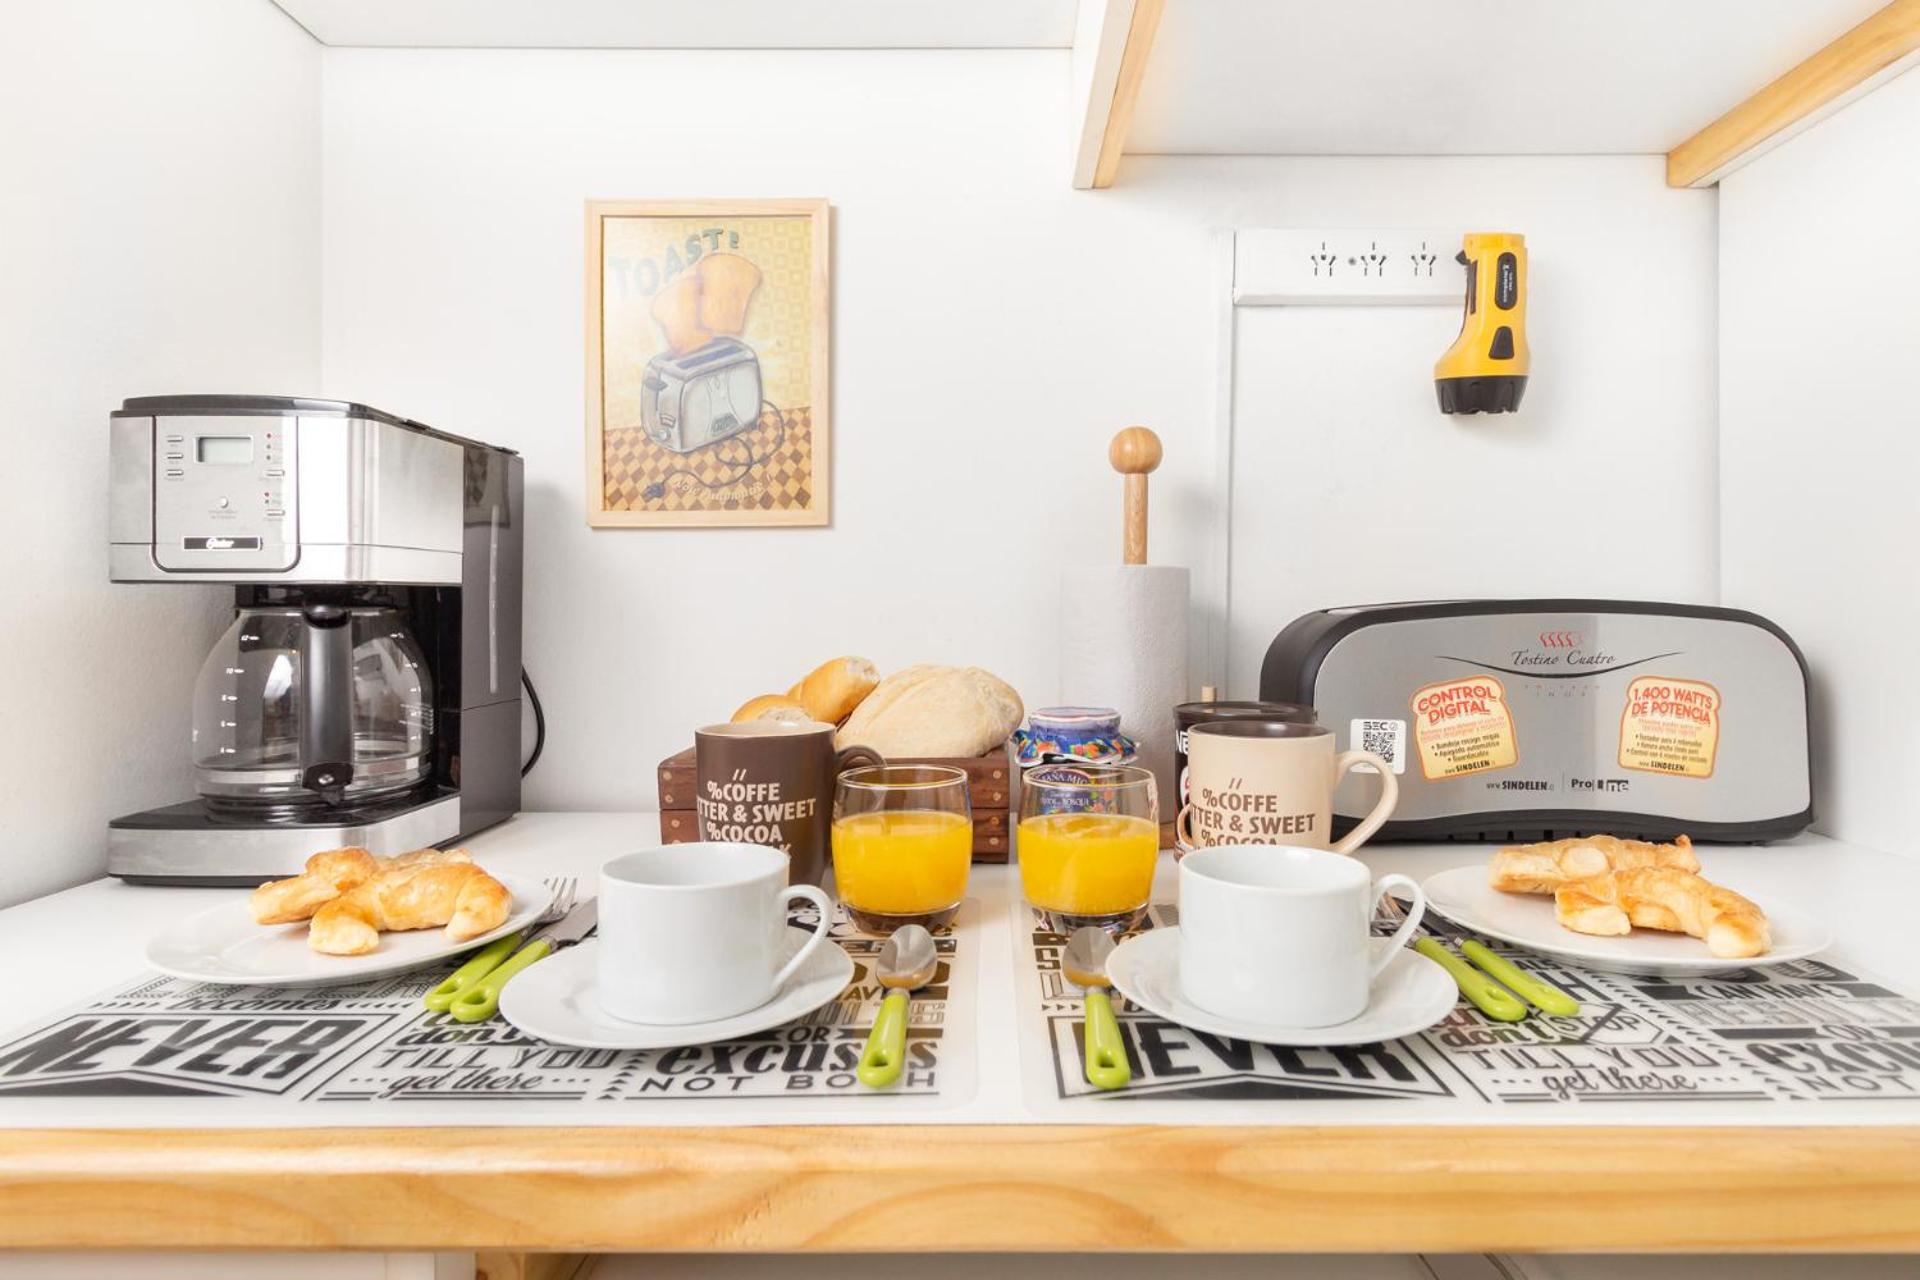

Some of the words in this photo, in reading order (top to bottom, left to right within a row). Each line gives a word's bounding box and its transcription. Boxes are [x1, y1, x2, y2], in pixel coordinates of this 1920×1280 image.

[1566, 649, 1616, 665] Cuatro
[1417, 685, 1497, 712] CONTROL
[1673, 687, 1713, 710] WATTS
[1428, 700, 1491, 725] DIGITAL
[1631, 702, 1649, 716] DE
[1651, 702, 1711, 723] POTENCIA
[707, 780, 781, 802] %COFFE
[1502, 780, 1548, 791] SINDELEN
[732, 804, 747, 823] &
[752, 798, 817, 824] SWEET
[1202, 788, 1278, 813] %COFFE
[706, 821, 783, 843] %COCOA
[1229, 814, 1243, 833] &
[1249, 813, 1316, 834] SWEET
[786, 1027, 830, 1043] OR
[1820, 1024, 1886, 1041] OR
[1, 1019, 368, 1080] NEVER
[374, 1048, 489, 1069] TILL
[510, 1048, 623, 1069] YOU
[654, 1041, 939, 1076] excuss
[1465, 1050, 1592, 1070] TILL
[1600, 1047, 1721, 1068] YOU
[378, 1070, 450, 1099] get
[451, 1066, 544, 1090] there
[639, 1075, 755, 1092] NOT
[784, 1071, 937, 1091] BOH
[1542, 1069, 1604, 1100] get
[1602, 1067, 1698, 1091] there
[1794, 1075, 1917, 1092] NOT
